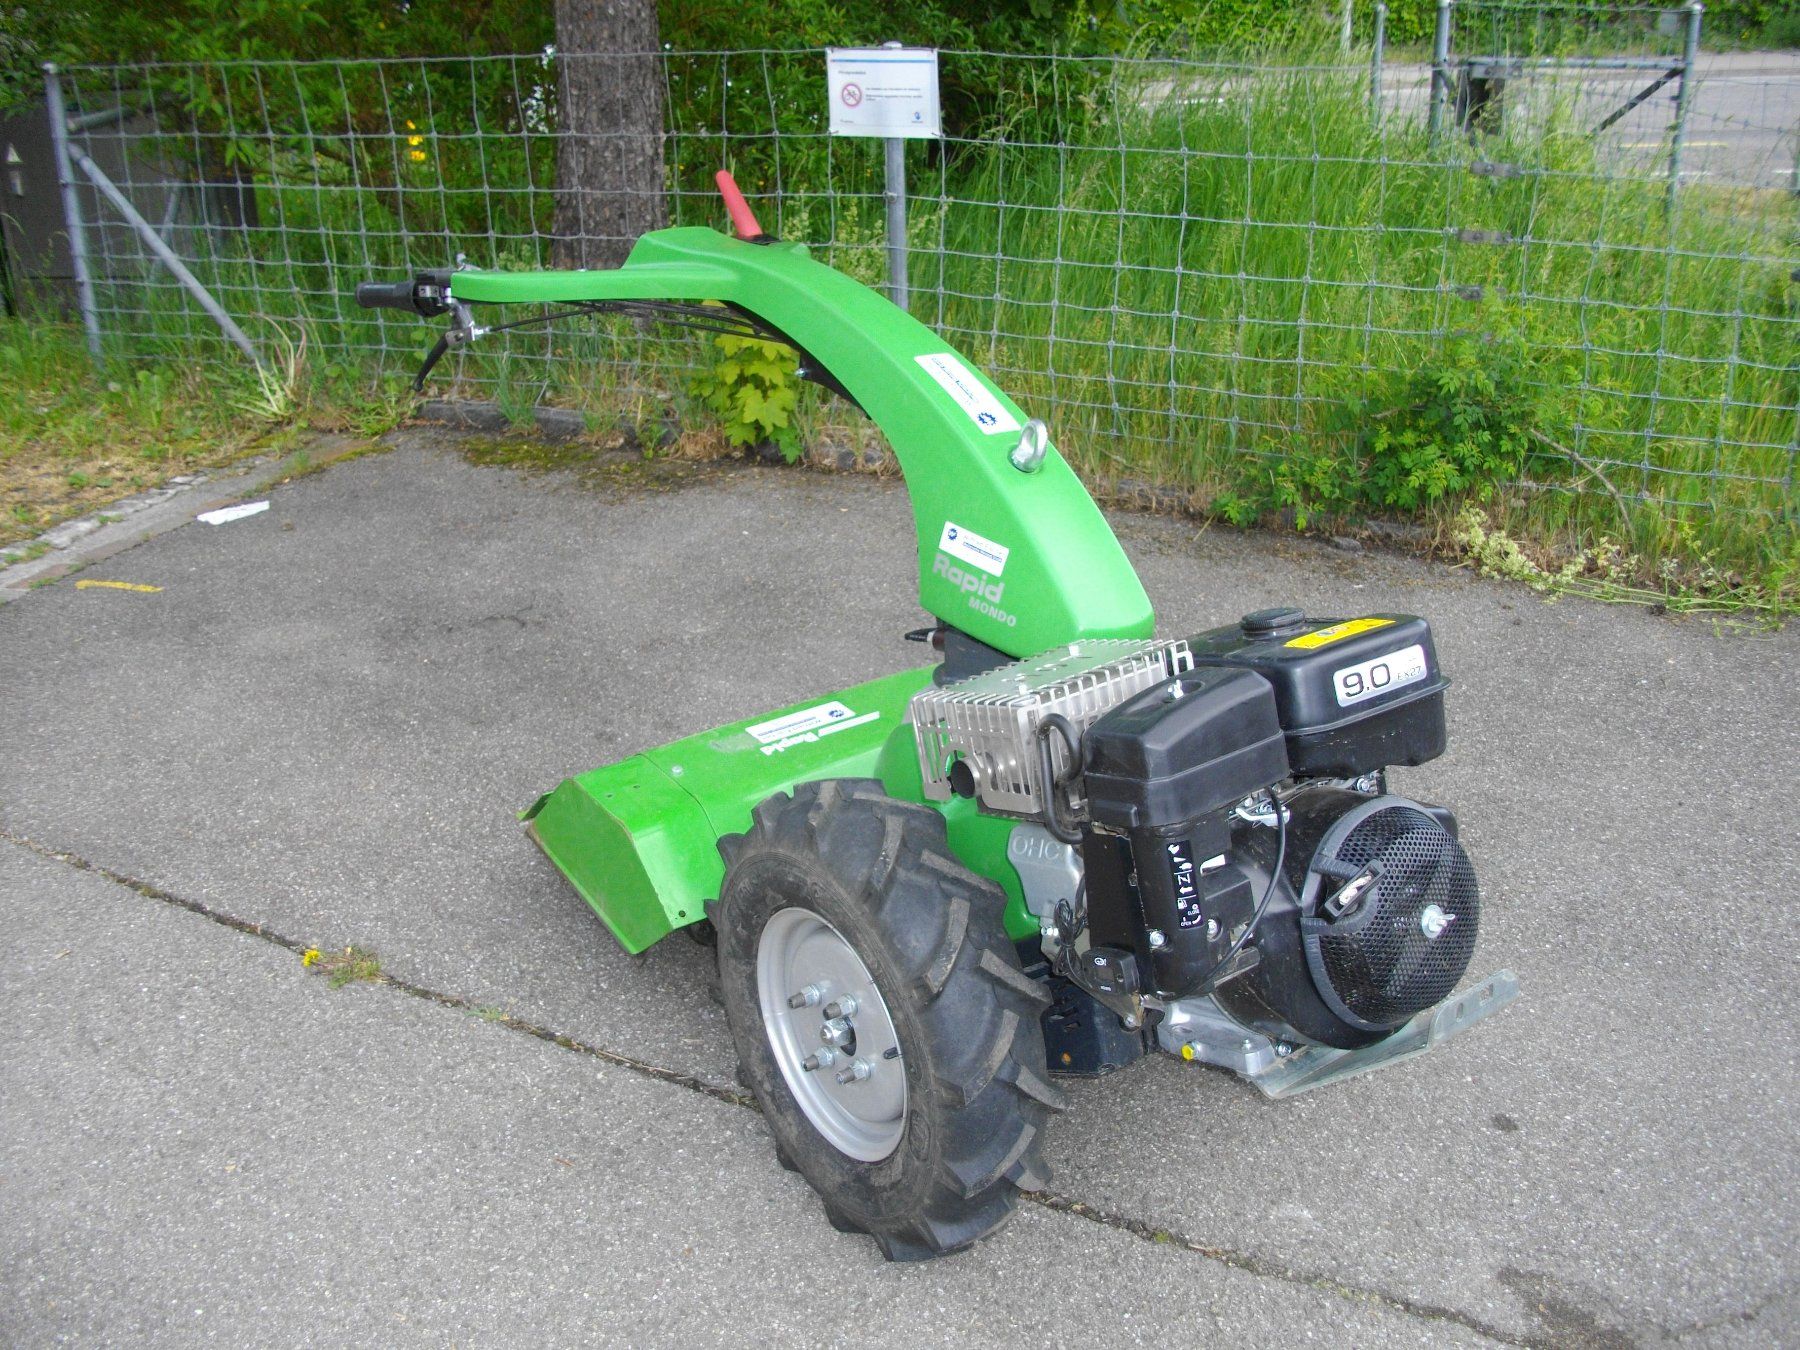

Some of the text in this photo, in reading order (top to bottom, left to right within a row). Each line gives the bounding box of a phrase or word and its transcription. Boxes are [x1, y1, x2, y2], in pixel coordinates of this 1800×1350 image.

[933, 553, 1005, 604] Rapid
[968, 597, 1017, 627] MONDO
[1342, 663, 1391, 698] 9.0
